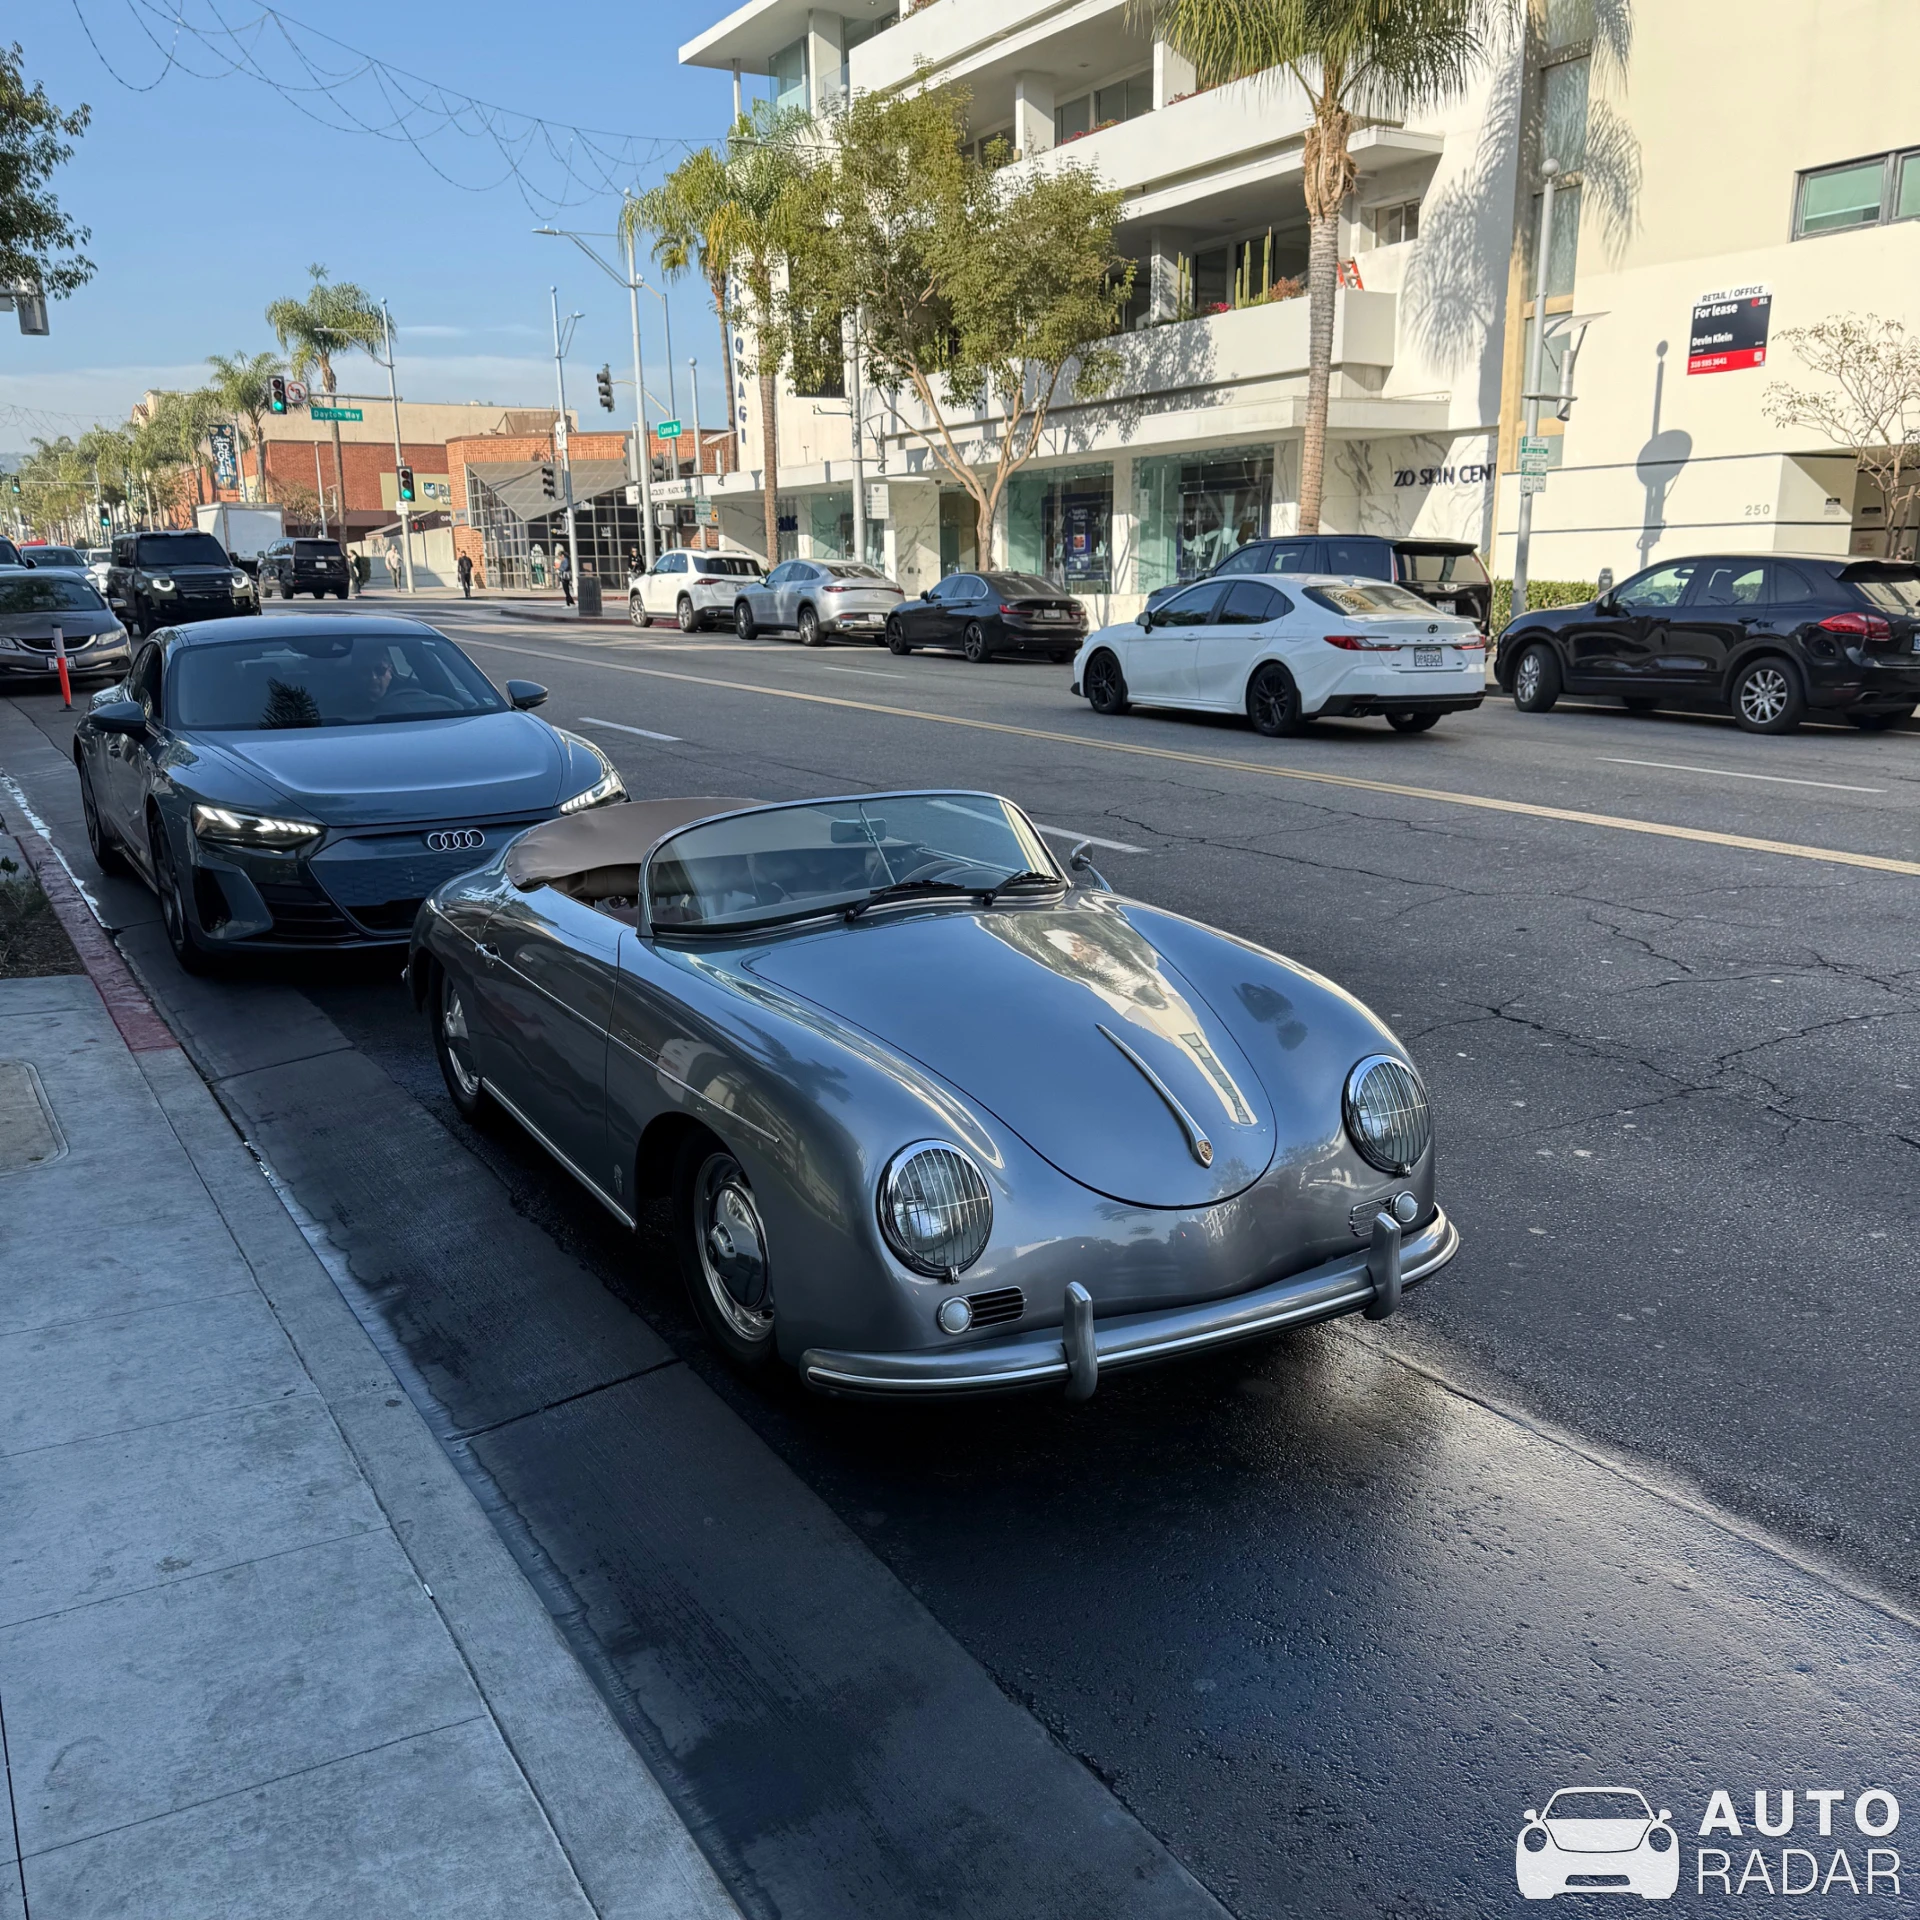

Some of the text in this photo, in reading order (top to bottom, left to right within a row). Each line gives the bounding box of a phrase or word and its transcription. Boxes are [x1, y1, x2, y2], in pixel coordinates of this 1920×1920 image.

[1702, 291, 1726, 302] RETAIL
[1734, 285, 1763, 297] OFFICE
[1694, 303, 1738, 319] For lease
[1691, 332, 1733, 347] Devin Klein
[313, 410, 361, 420] Dayton Way
[1393, 469, 1416, 487] ZO
[1419, 466, 1455, 486] SKIN
[1744, 504, 1770, 516] 250
